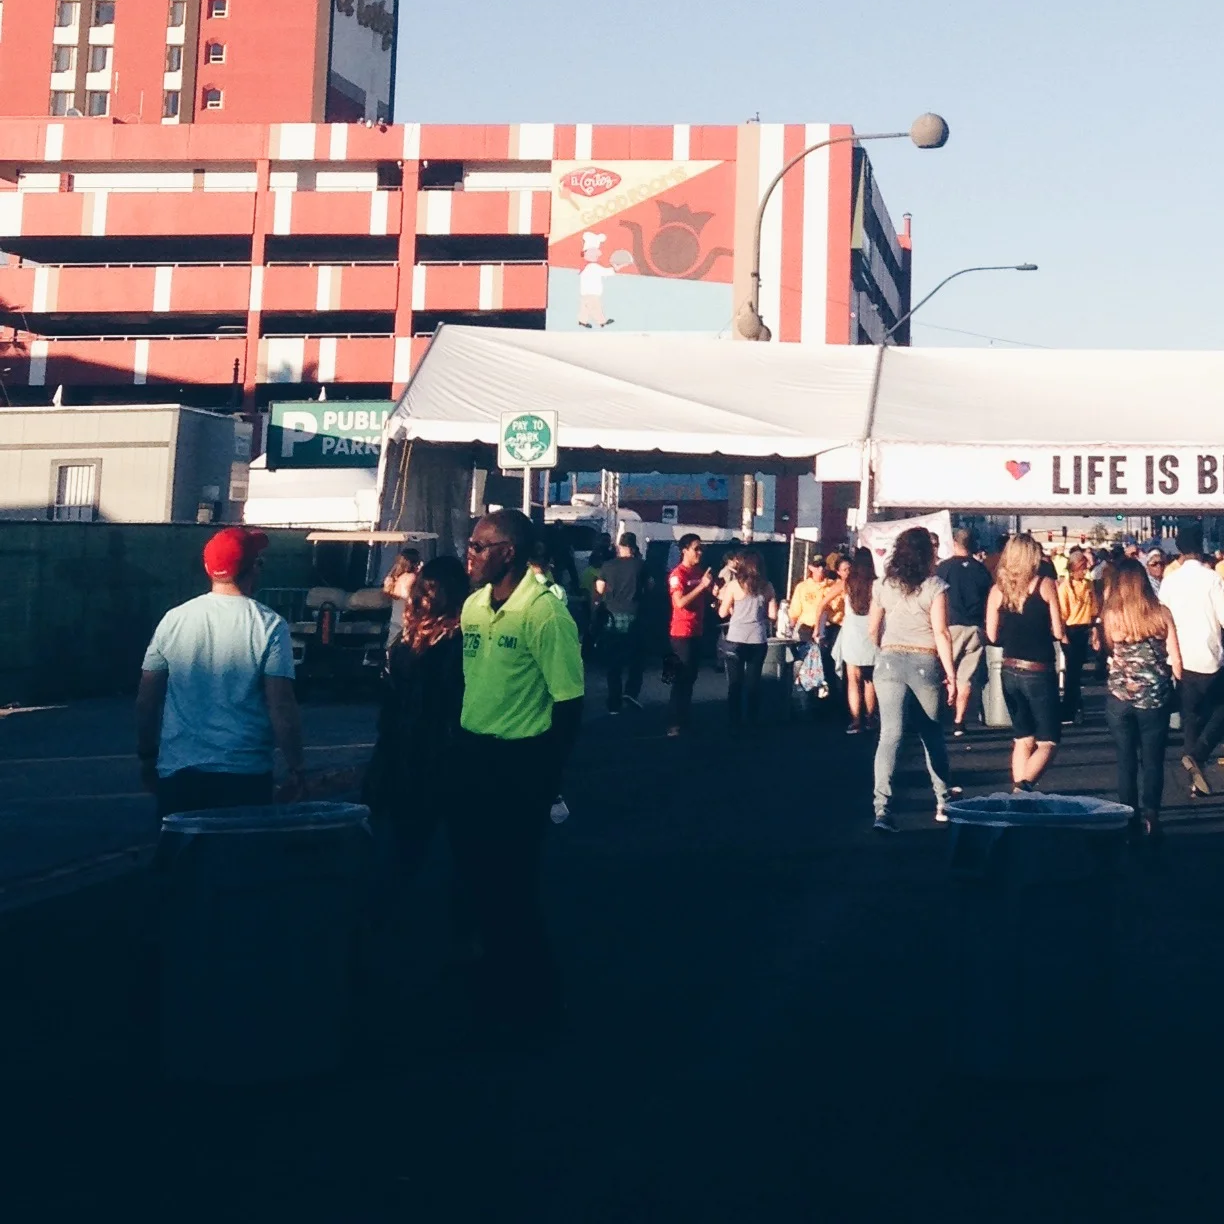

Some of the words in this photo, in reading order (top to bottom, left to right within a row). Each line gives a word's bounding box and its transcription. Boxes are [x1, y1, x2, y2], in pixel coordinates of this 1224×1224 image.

[281, 411, 318, 457] P
[512, 420, 528, 431] PAY
[532, 419, 544, 431] TO
[1052, 455, 1128, 495] LIFE
[1145, 455, 1180, 495] IS
[498, 635, 518, 649] CMI
